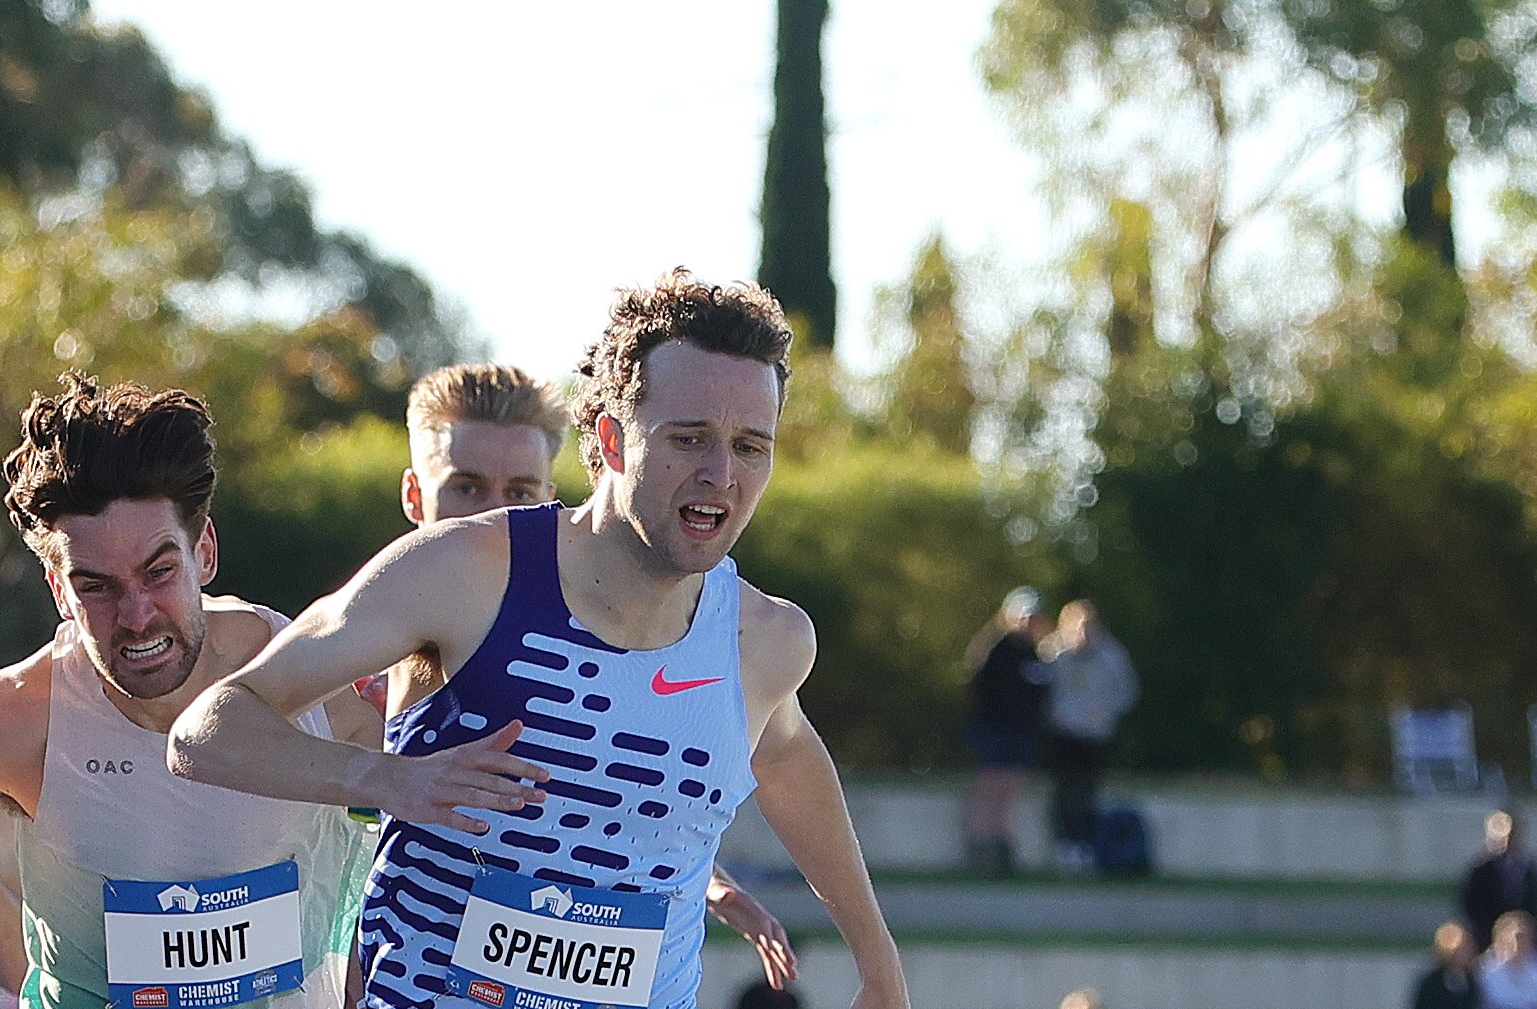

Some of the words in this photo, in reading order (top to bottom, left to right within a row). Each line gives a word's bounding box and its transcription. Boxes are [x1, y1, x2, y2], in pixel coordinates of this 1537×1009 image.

[86, 759, 133, 775] OAC
[201, 885, 249, 906] SOUTH
[202, 898, 249, 912] AUSTRALIA
[572, 902, 622, 920] SOUTH
[570, 915, 618, 926] AUSTRALIA
[163, 921, 250, 969] HUNT
[483, 922, 636, 988] SPENCER
[135, 993, 166, 1002] CHEMIST
[178, 980, 240, 999] CHEMIST
[179, 994, 239, 1007] WAREHOUSE
